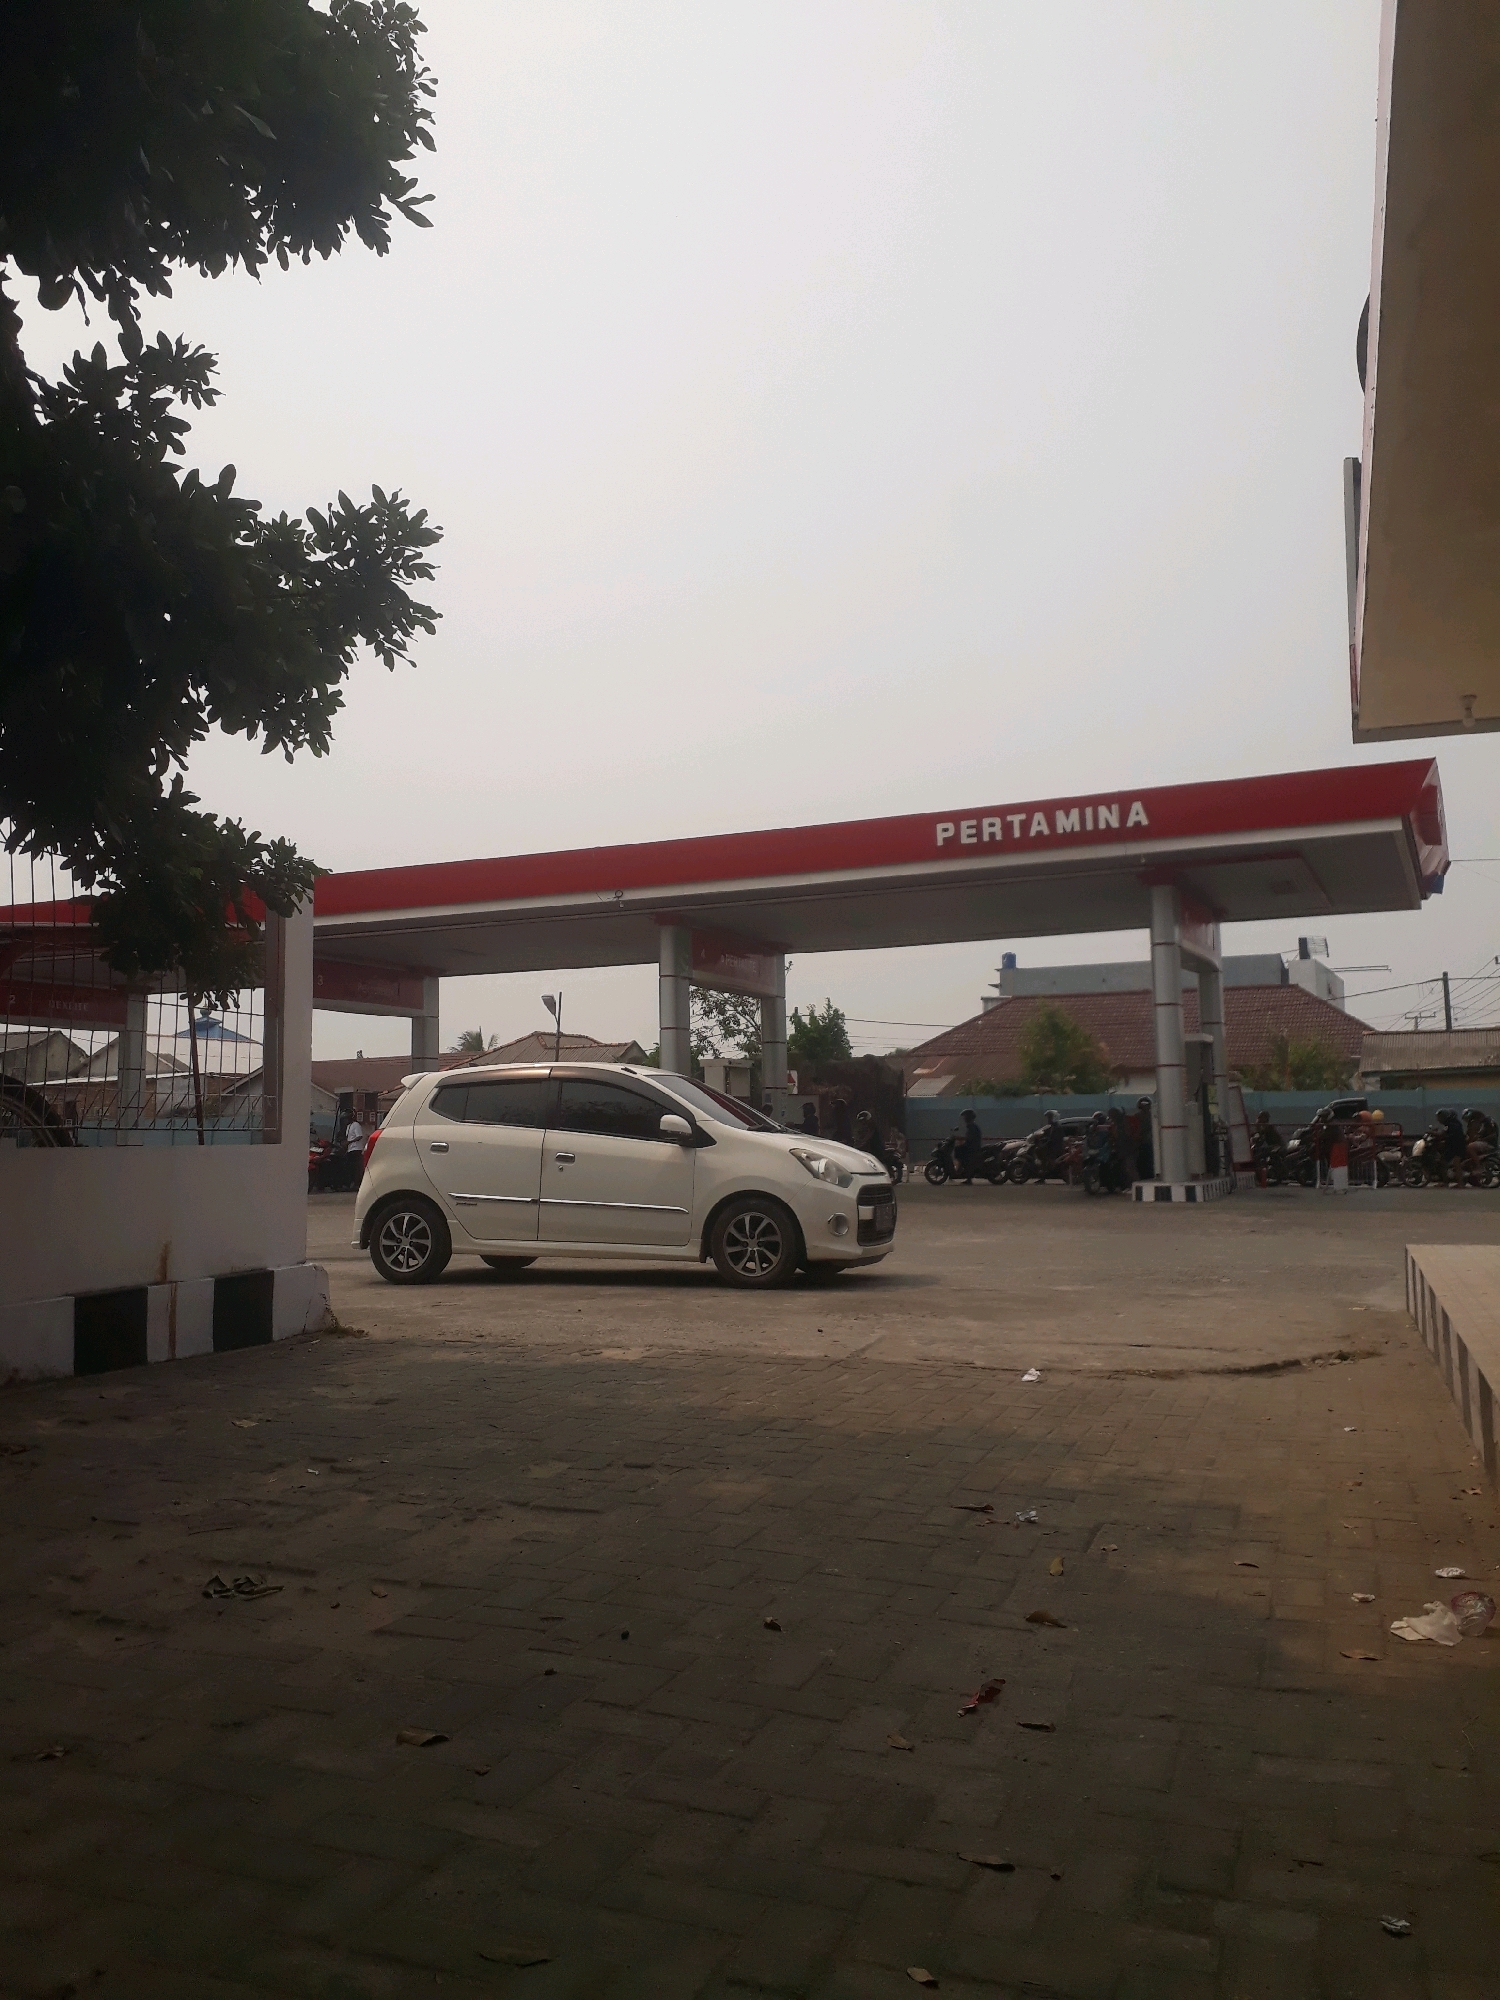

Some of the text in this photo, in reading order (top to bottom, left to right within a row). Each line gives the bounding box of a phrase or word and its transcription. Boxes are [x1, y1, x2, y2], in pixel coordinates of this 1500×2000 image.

[936, 801, 1149, 846] PERTAMINA
[317, 974, 324, 986] 3
[9, 994, 16, 1004] 2
